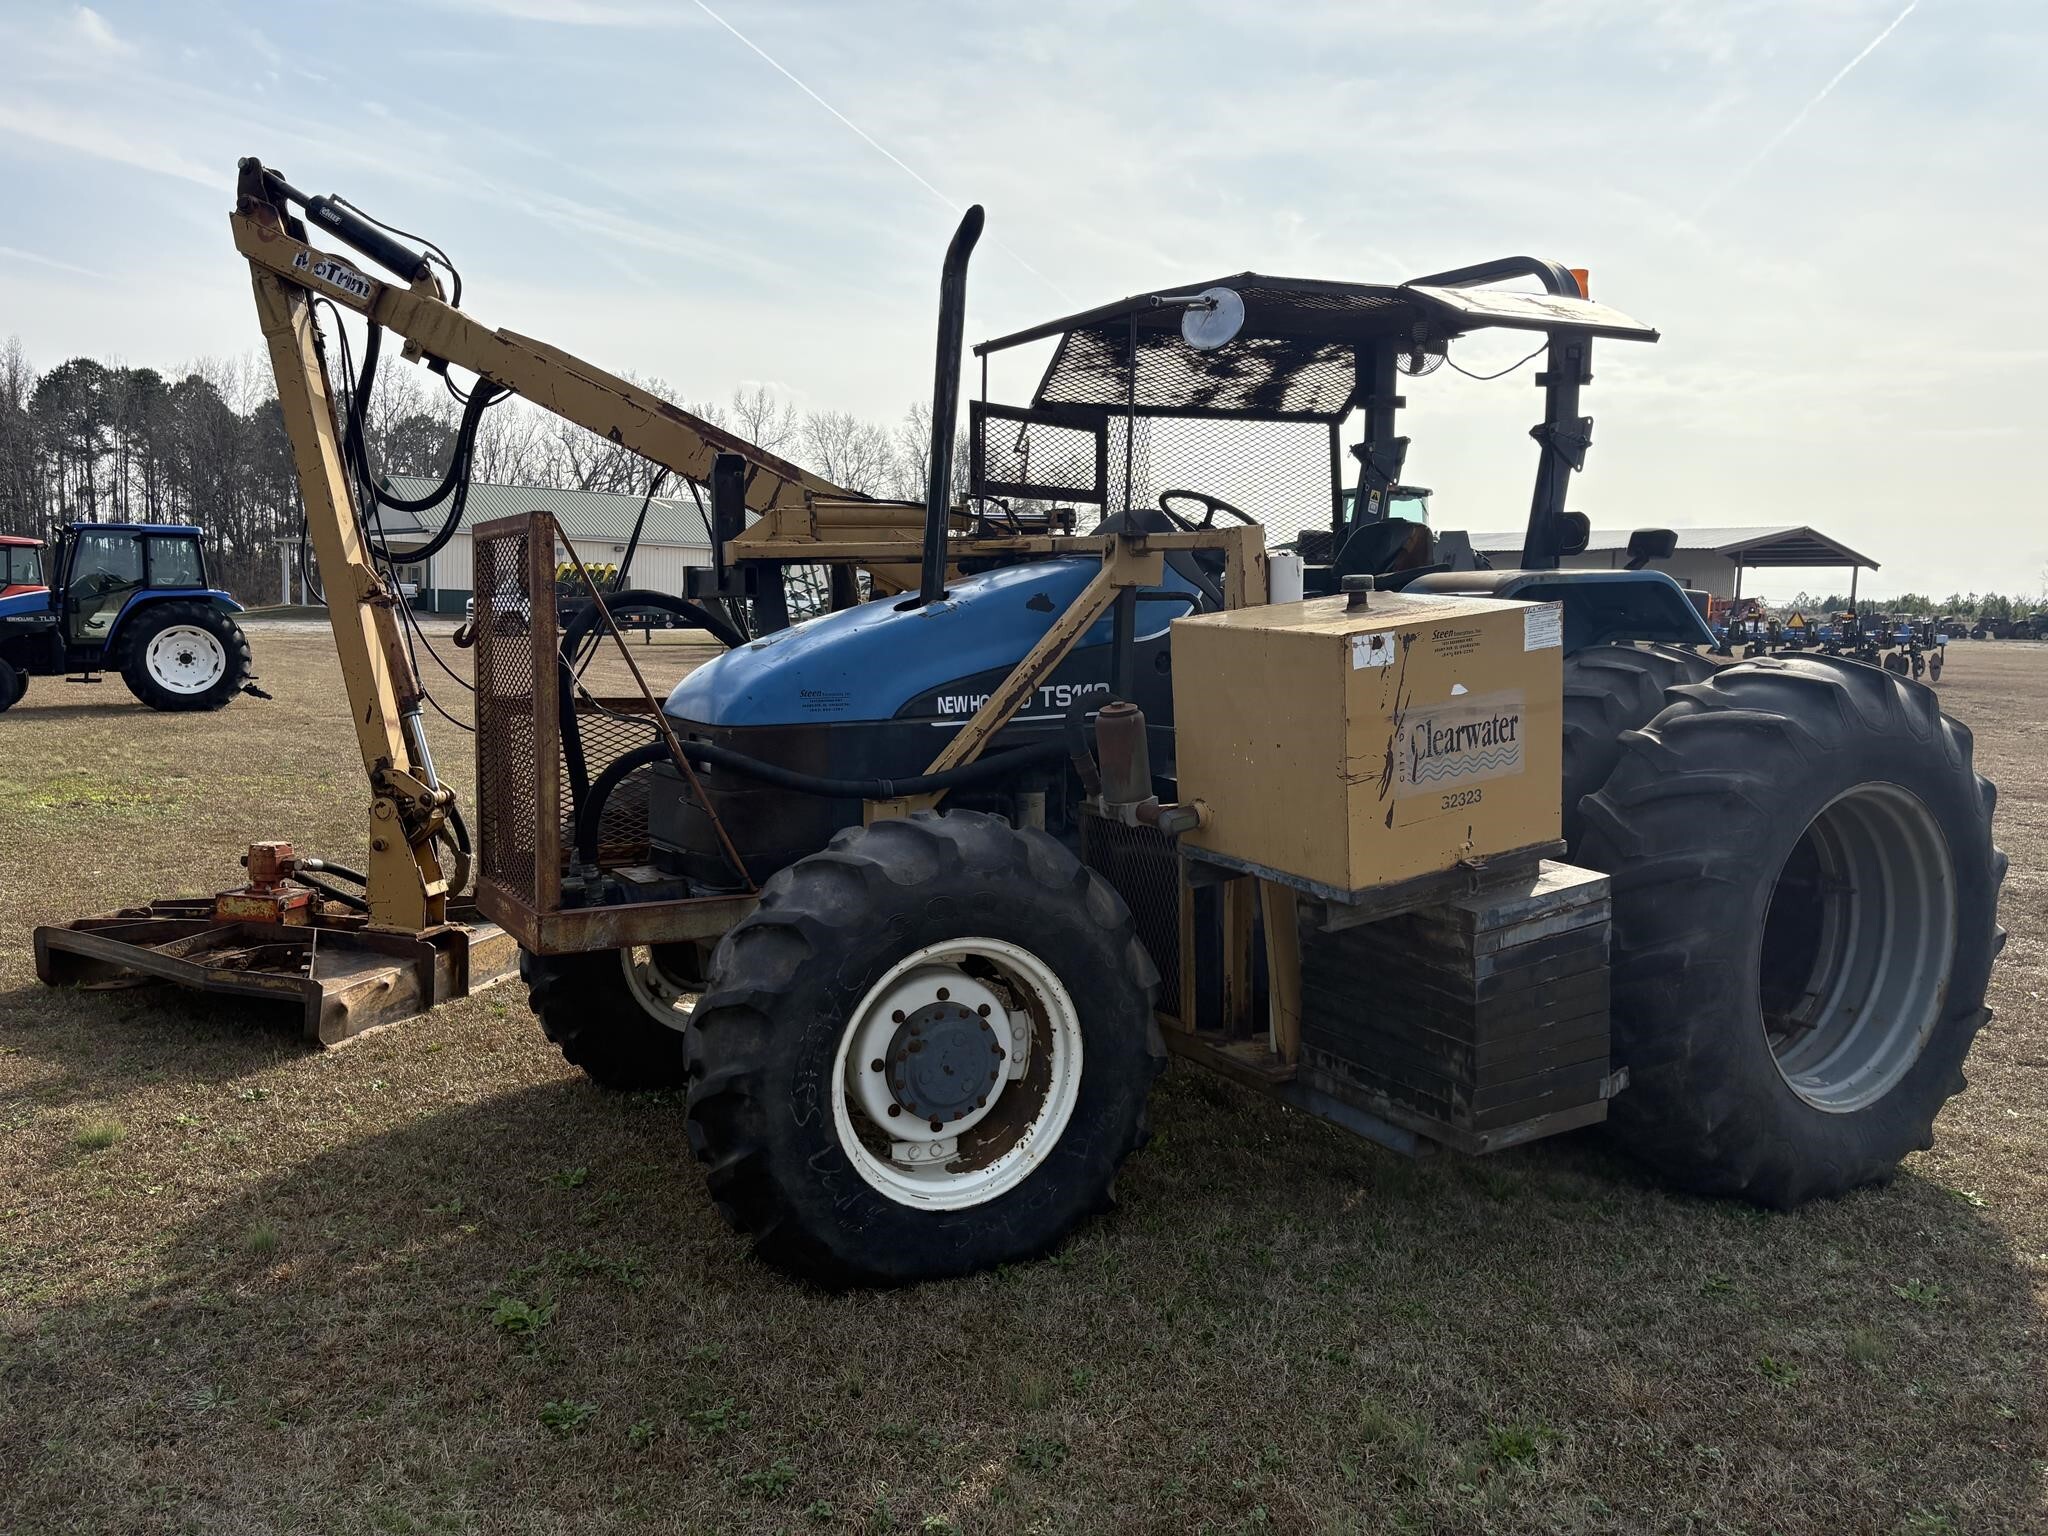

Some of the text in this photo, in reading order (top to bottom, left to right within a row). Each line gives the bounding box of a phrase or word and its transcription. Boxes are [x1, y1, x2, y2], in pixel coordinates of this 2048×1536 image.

[937, 696, 968, 714] NEW
[1411, 713, 1519, 761] Clearwater
[1441, 788, 1482, 810] 32323
